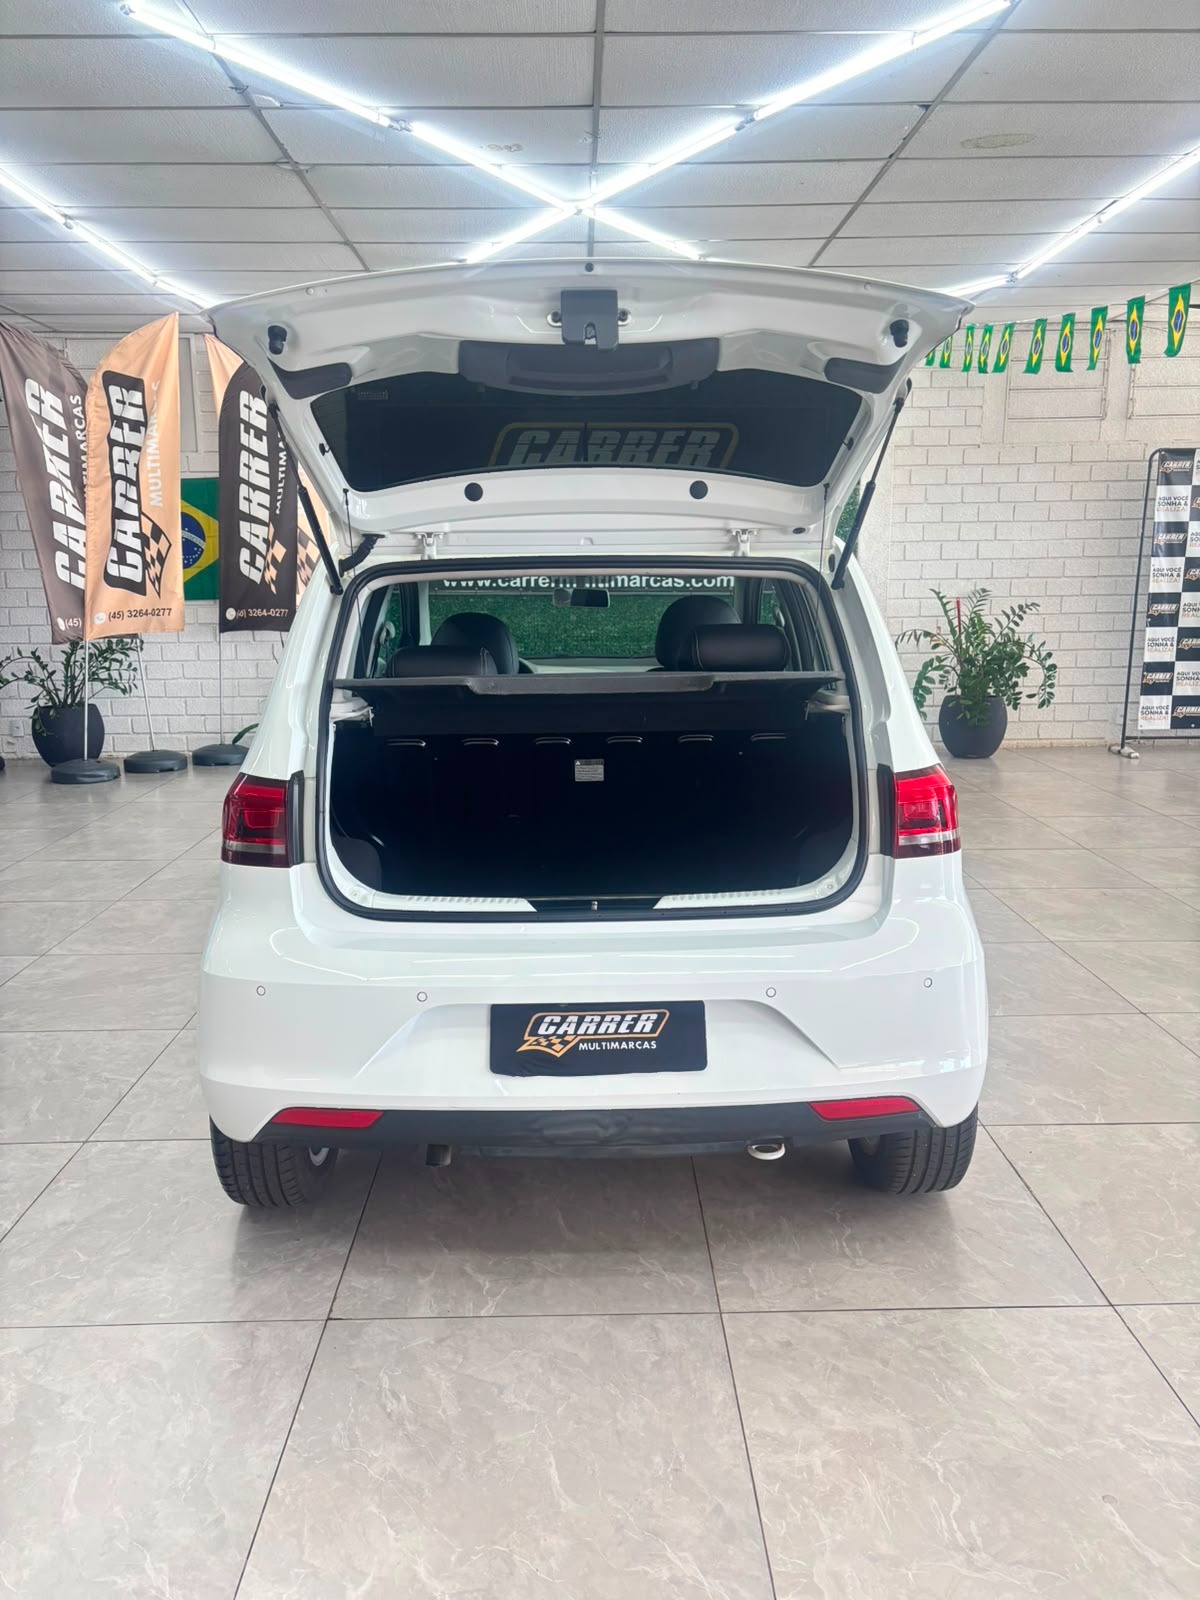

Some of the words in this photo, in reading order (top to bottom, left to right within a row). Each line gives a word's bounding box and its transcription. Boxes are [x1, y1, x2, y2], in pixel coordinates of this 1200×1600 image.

[508, 430, 720, 466] CARRER
[106, 384, 146, 584] CARRER
[239, 390, 271, 585] CARRER
[108, 611, 125, 622] (45)
[127, 608, 172, 618] 3264-0277
[247, 608, 289, 617] 3264-0277
[65, 618, 82, 629] (45)
[537, 1013, 658, 1035] CARRER
[578, 1040, 657, 1051] MULTIMARCAS
